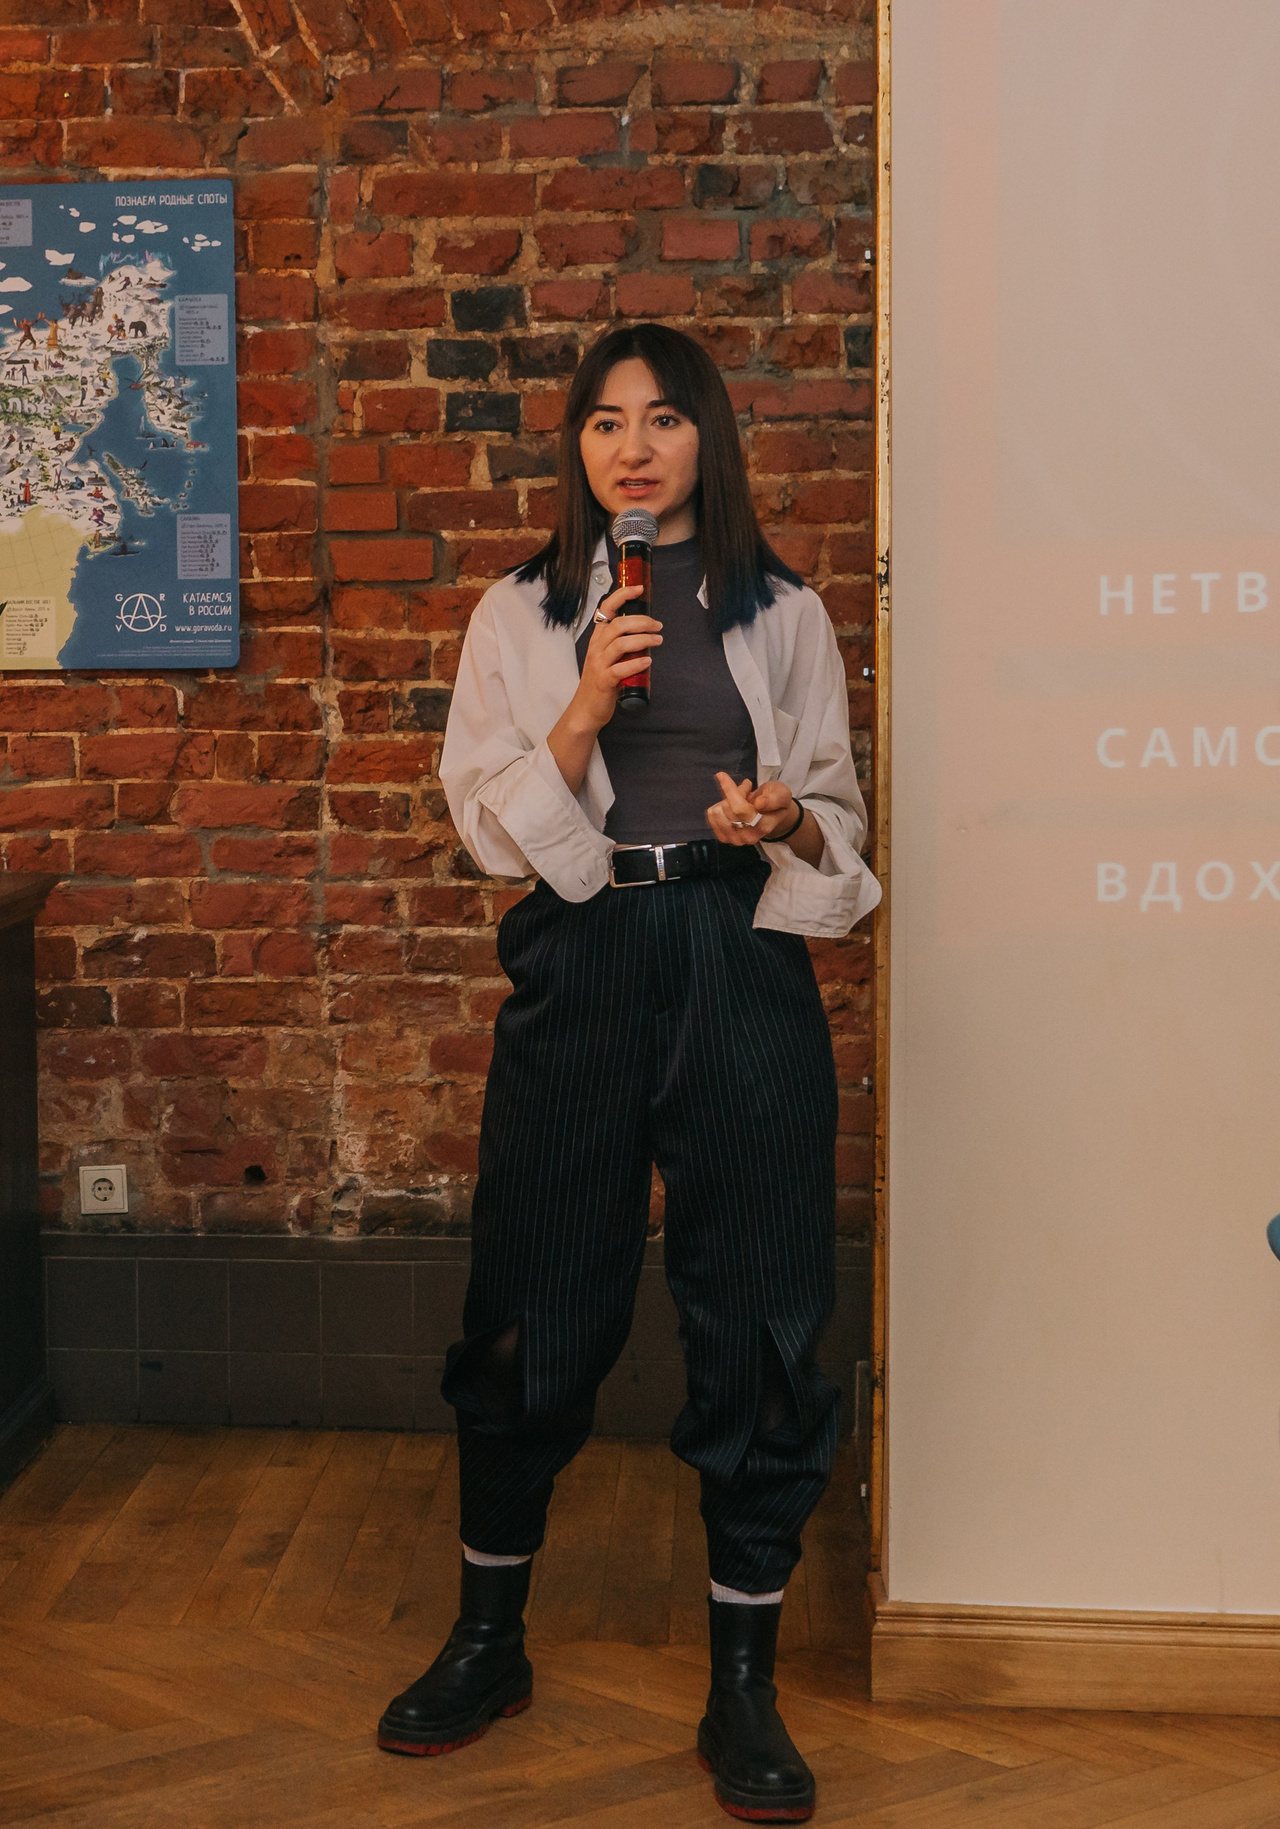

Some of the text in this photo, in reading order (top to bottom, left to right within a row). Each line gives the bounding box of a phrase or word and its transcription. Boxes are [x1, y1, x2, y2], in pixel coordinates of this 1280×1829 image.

[115, 193, 228, 207] ПОЗНАЕМ РОДНЫЕ СПОТЫ
[182, 592, 232, 603] КАТАЕМСЯ
[1098, 572, 1269, 615] НЕТВ
[189, 605, 232, 616] В РОССИИ
[175, 623, 232, 634] www.goravoda.ru
[1097, 860, 1280, 913] ВДОХ
